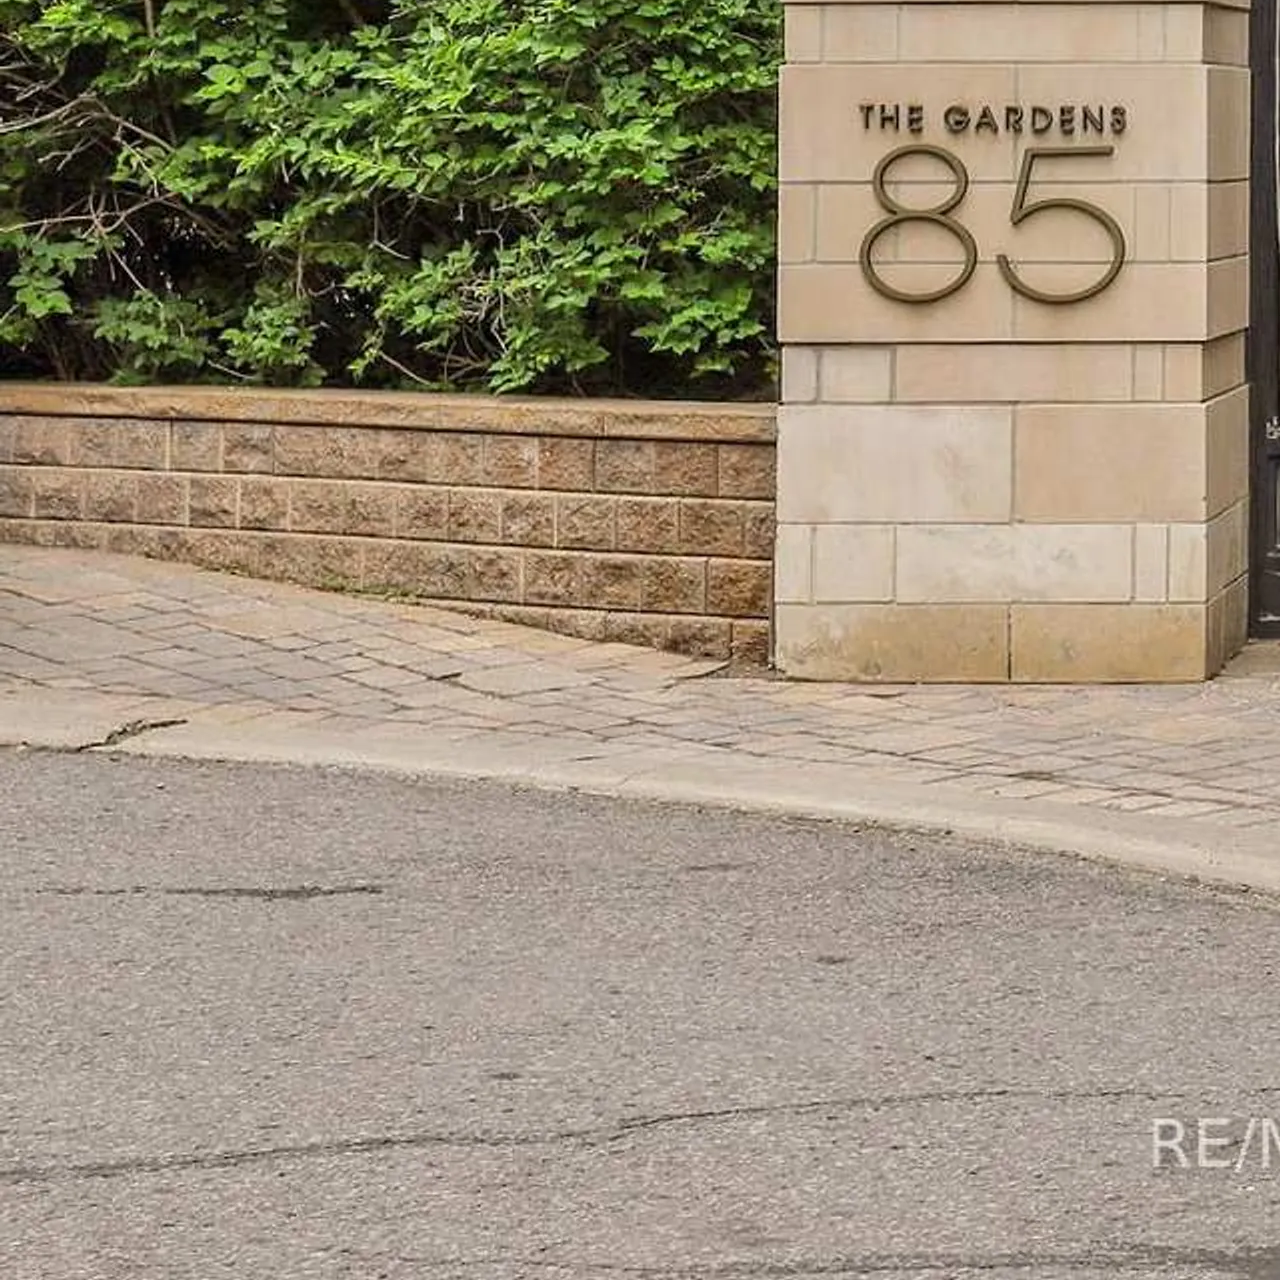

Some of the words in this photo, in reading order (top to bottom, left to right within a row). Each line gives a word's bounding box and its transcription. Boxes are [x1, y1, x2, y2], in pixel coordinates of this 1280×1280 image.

[858, 104, 924, 134] THE
[943, 104, 1128, 135] GARDENS
[859, 143, 1126, 305] 85
